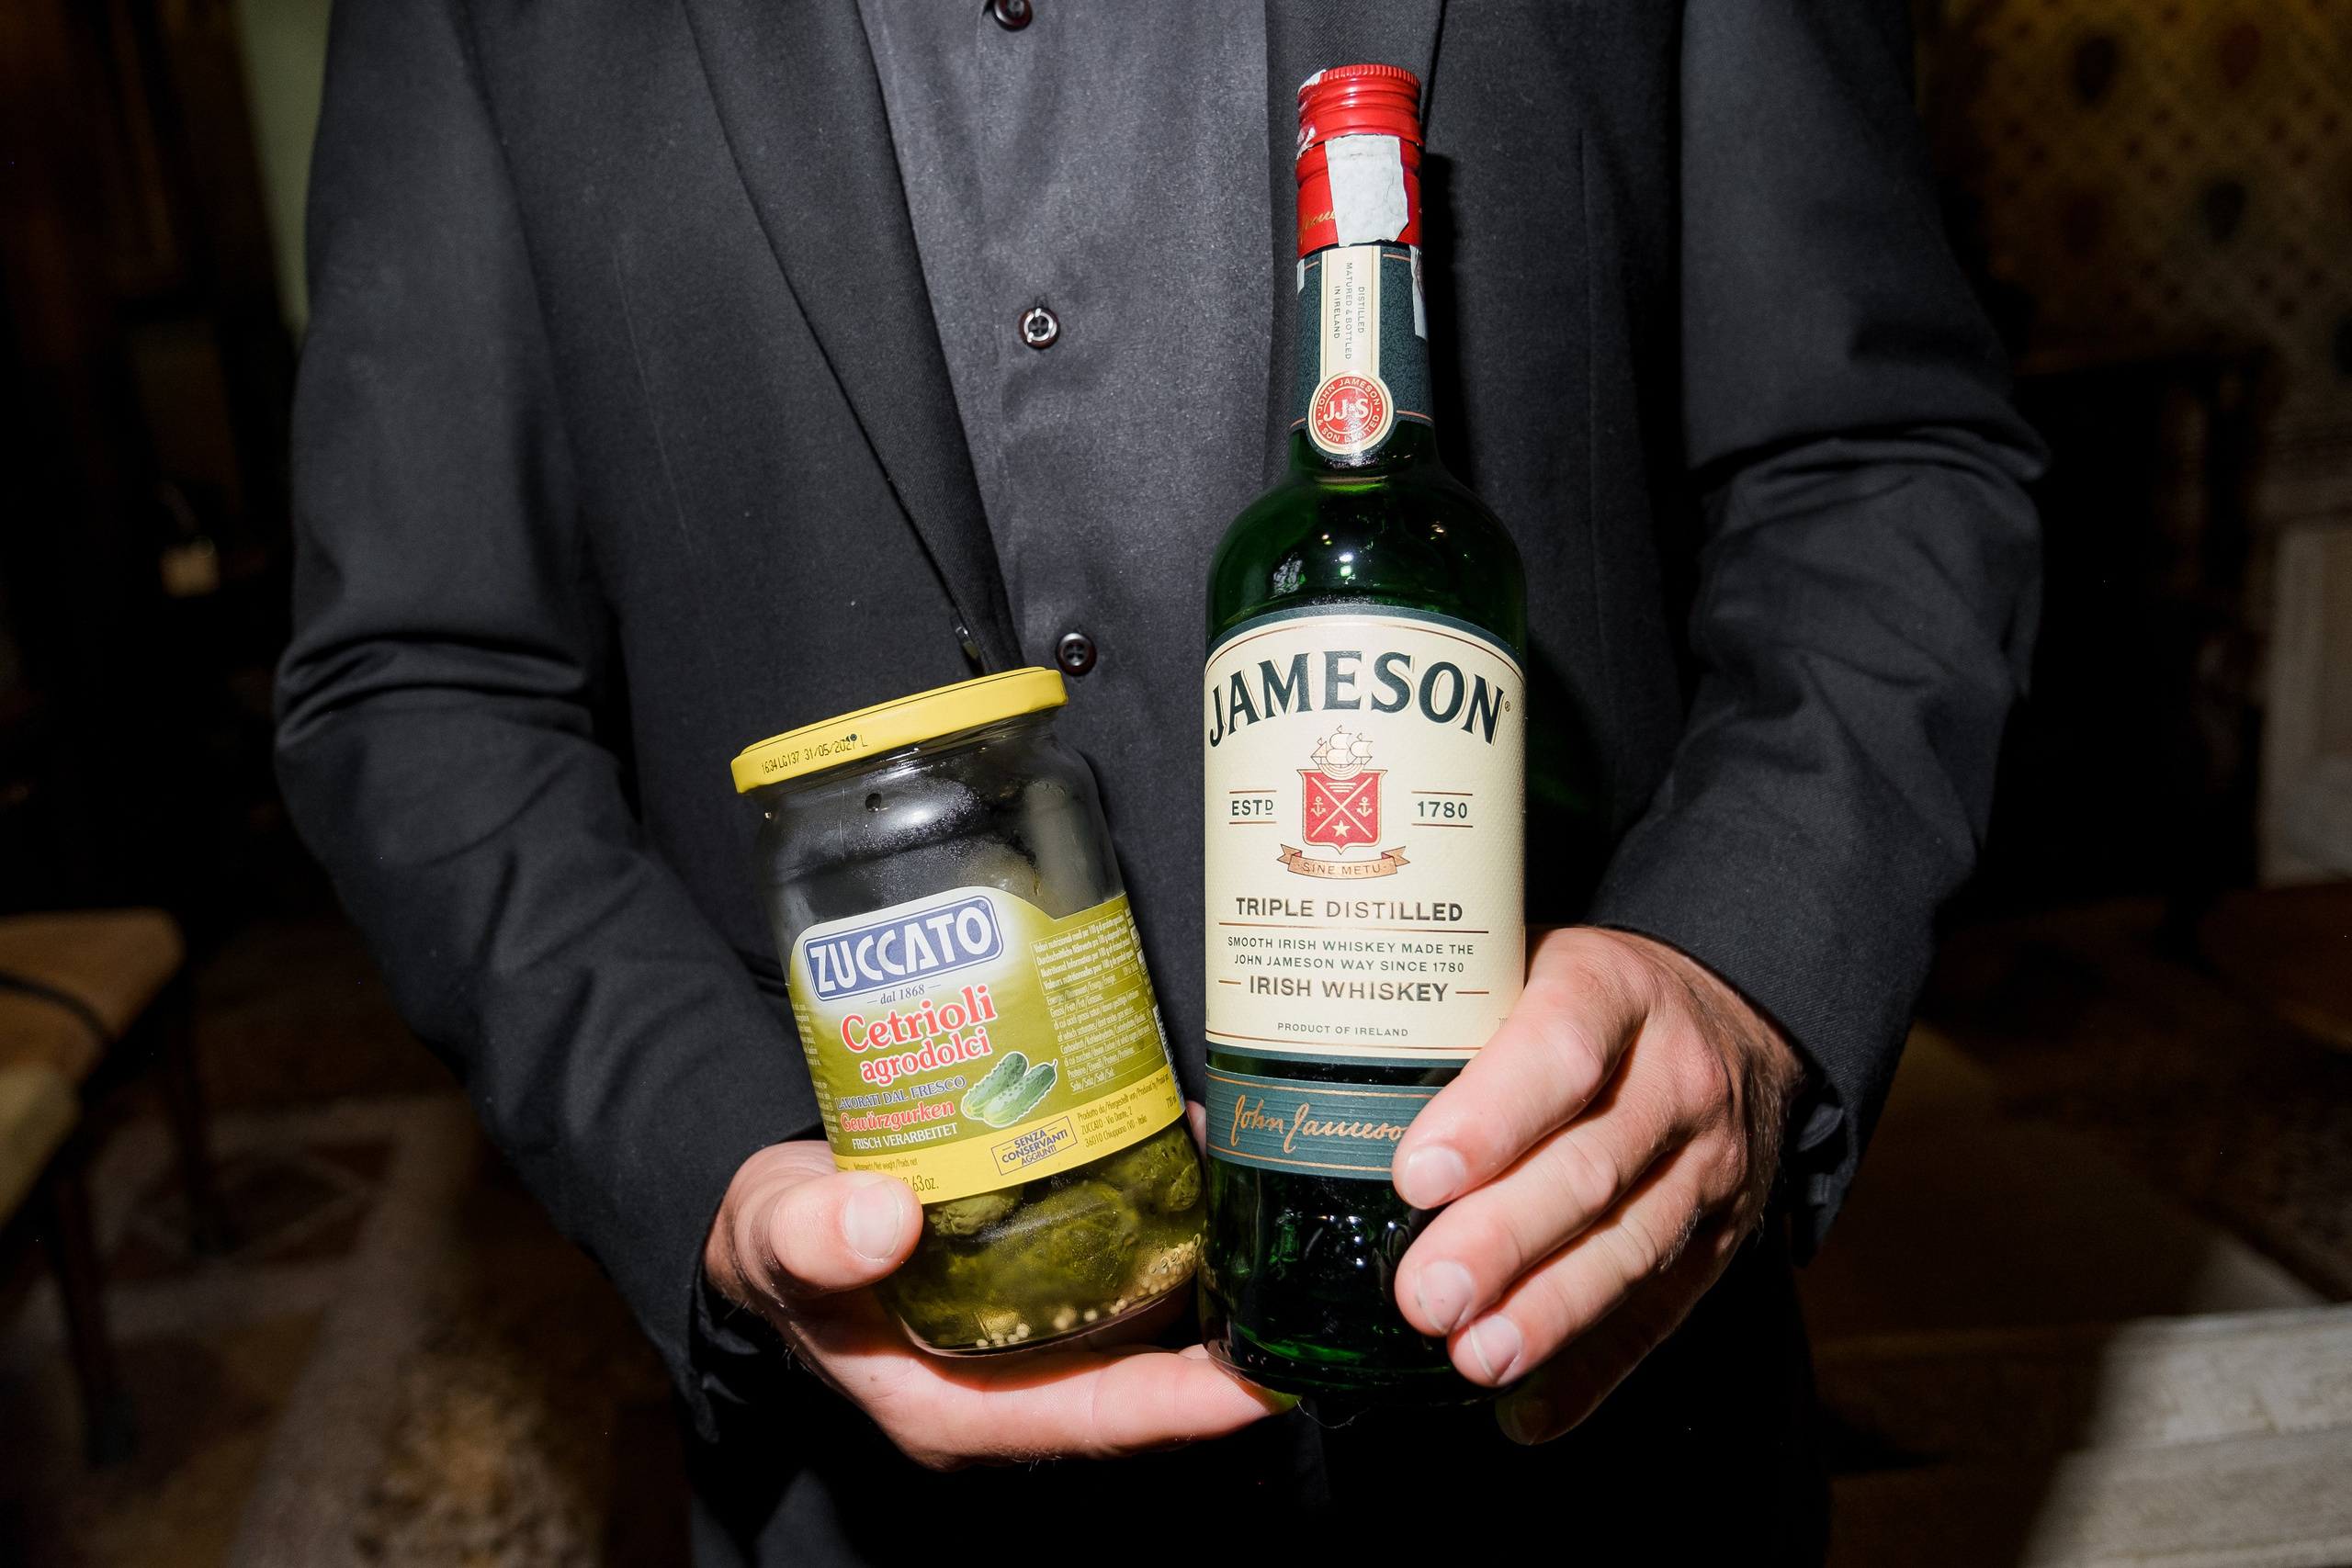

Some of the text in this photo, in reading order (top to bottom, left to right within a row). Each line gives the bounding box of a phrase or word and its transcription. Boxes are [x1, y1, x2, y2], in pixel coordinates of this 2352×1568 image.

[1334, 286, 1340, 294] IN
[1317, 378, 1381, 411] JOHN JAMESON
[1322, 427, 1340, 442] SON
[1417, 800, 1468, 819] 1780
[1302, 862, 1381, 875] SINE METU
[1236, 897, 1463, 921] TRIPLE DISTILLED
[1227, 936, 1474, 954] SMOOTH IRISH WHISKEY MADE THE
[1234, 954, 1464, 973] JOHN JAMESON WAY SINCE 1780
[880, 985, 925, 1005] dal 1868
[1250, 975, 1449, 1002] IRISH WHISKEY
[841, 985, 996, 1052] Cetrioli
[1278, 1022, 1408, 1037] PRODUCT OF IRELAND
[861, 1028, 991, 1085] agrodolci
[836, 1076, 966, 1110] LAVORATI DAL FRESCO
[840, 1100, 956, 1132] Gewürzgurken
[1231, 1094, 1410, 1154] John Jameso
[852, 1122, 957, 1149] FRISCH VERARBEITET
[1001, 1129, 1069, 1163] CONSERVANTI
[1014, 1129, 1046, 1148] SENZA
[1021, 1145, 1057, 1166] AGGIUNTI
